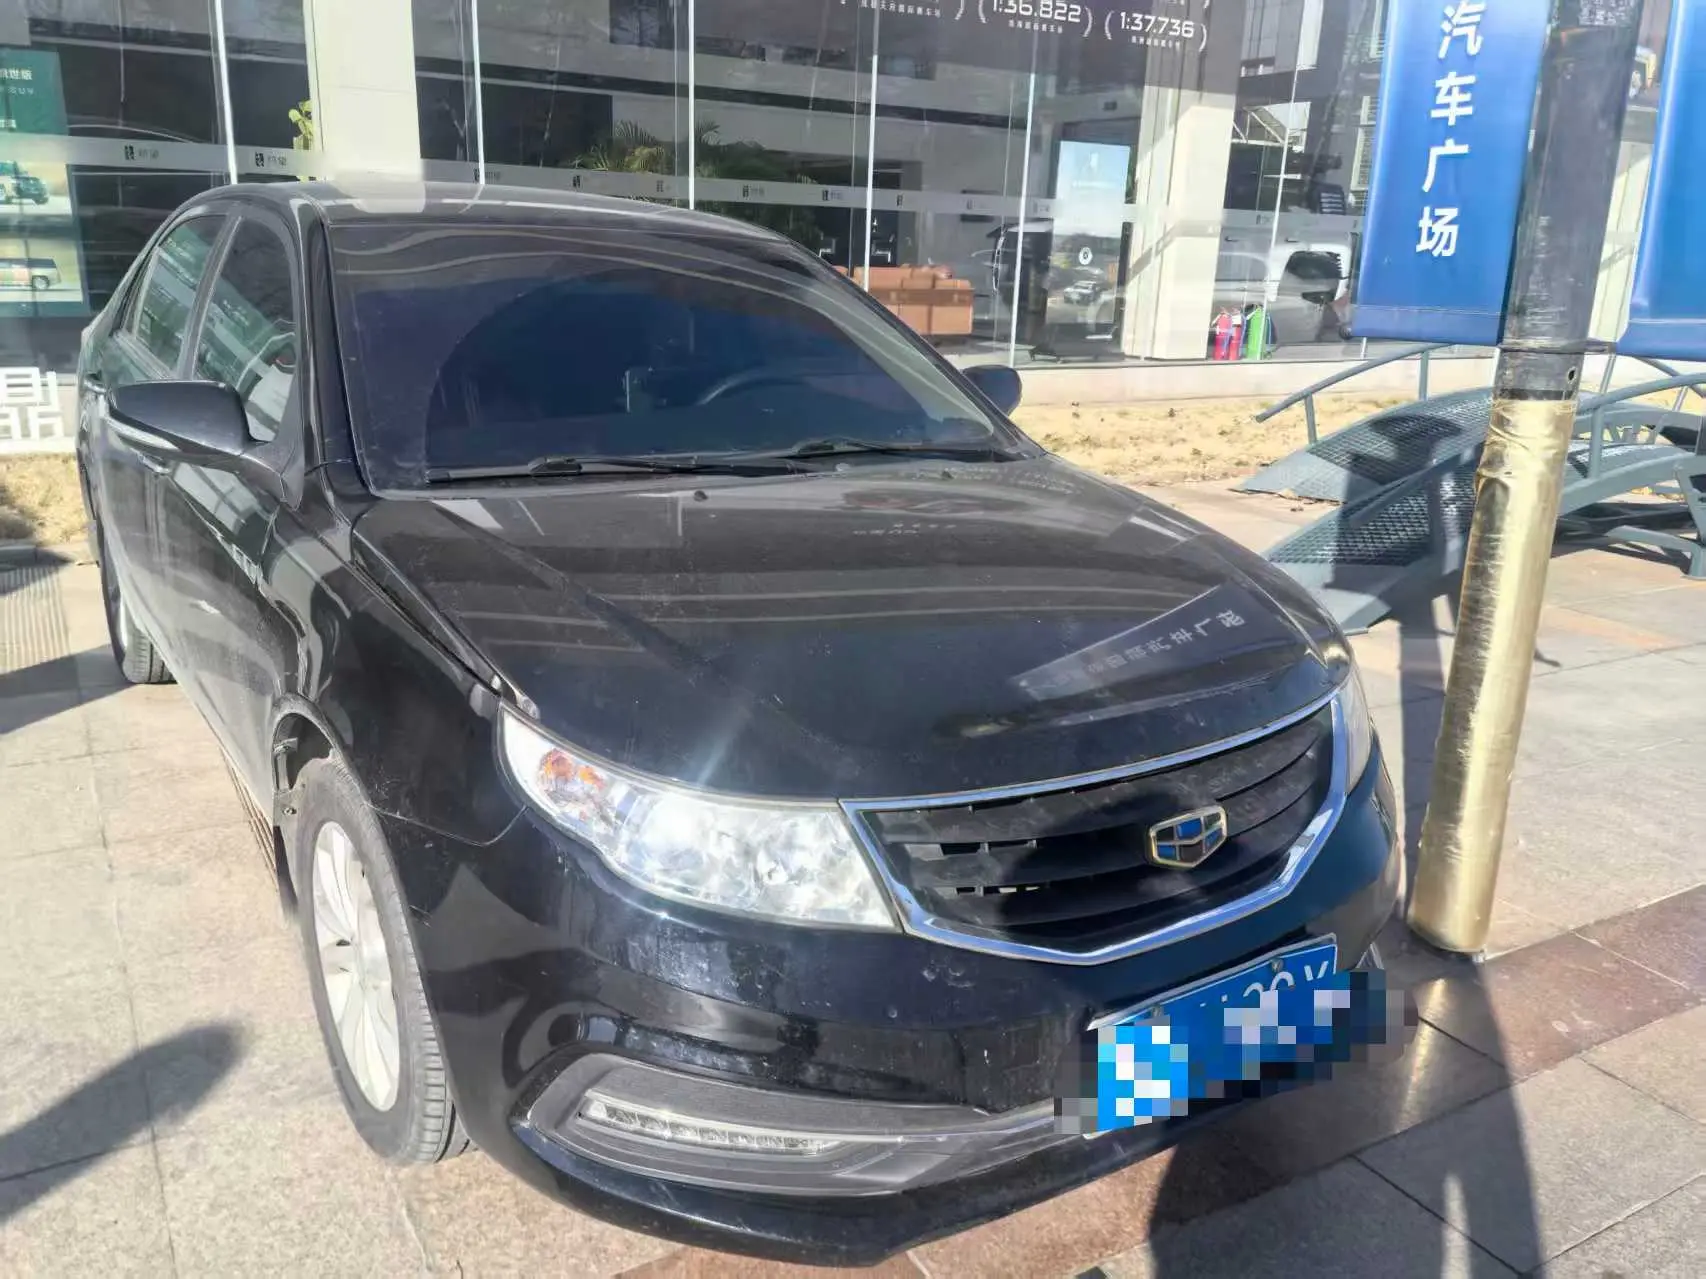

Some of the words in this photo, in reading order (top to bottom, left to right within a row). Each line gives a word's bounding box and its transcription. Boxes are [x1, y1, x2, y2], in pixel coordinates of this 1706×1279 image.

[1120, 11, 1195, 38] 1:37.736
[1415, 0, 1486, 258] 汽车广场
